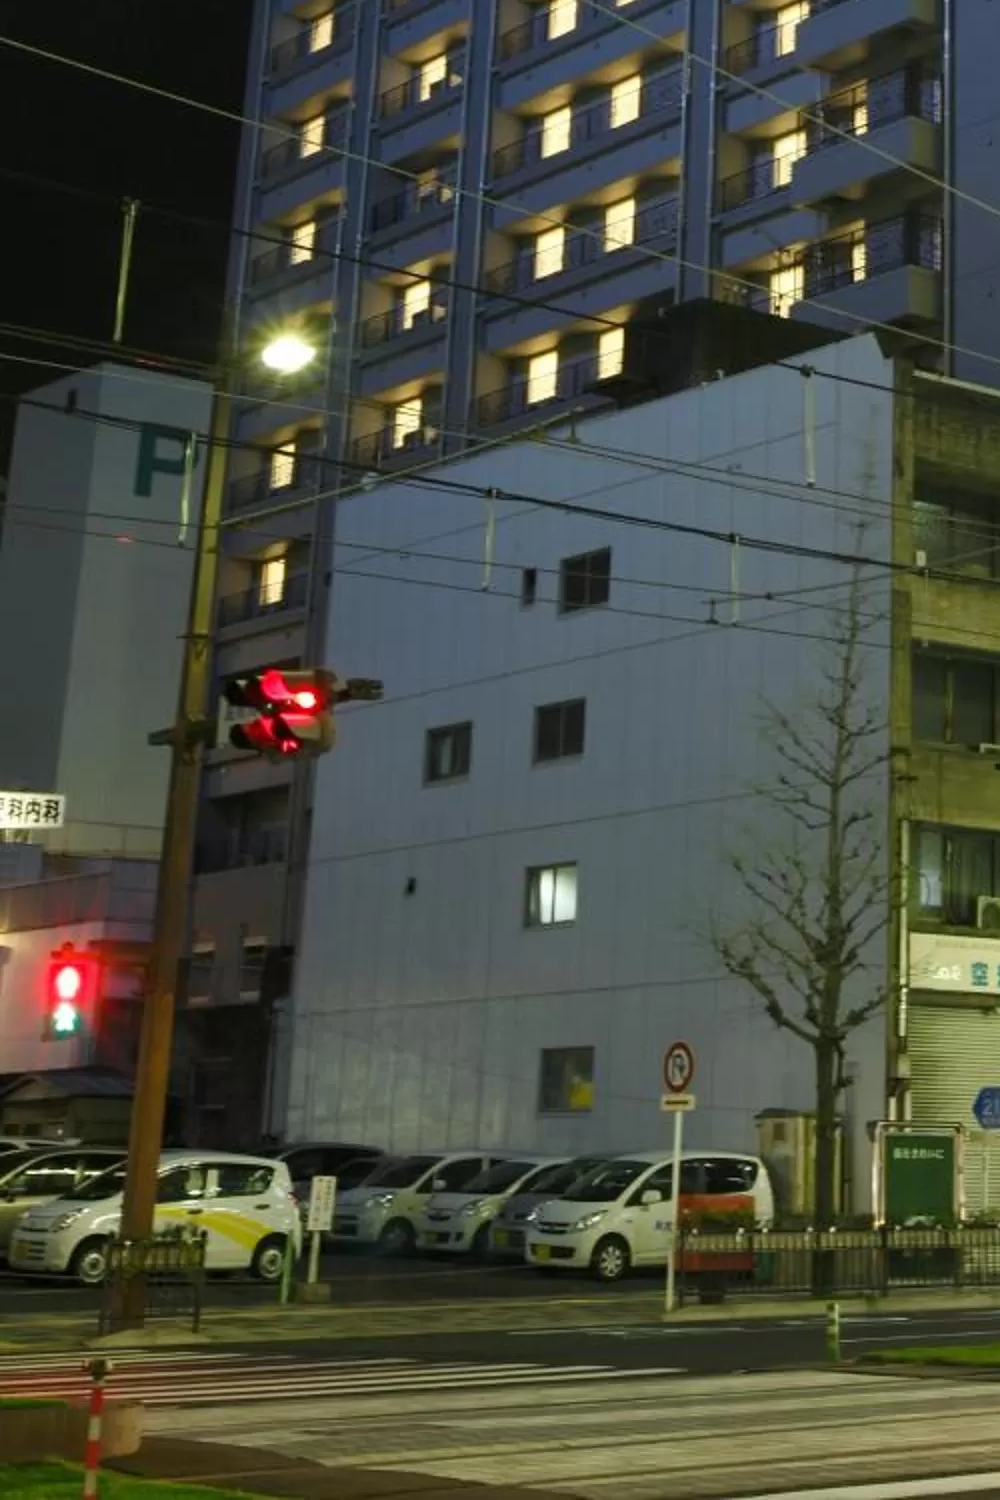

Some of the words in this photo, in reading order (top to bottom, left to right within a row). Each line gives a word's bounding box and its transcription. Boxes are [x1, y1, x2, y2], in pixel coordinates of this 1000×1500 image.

[133, 422, 199, 497] P
[0, 798, 60, 824] 科内科
